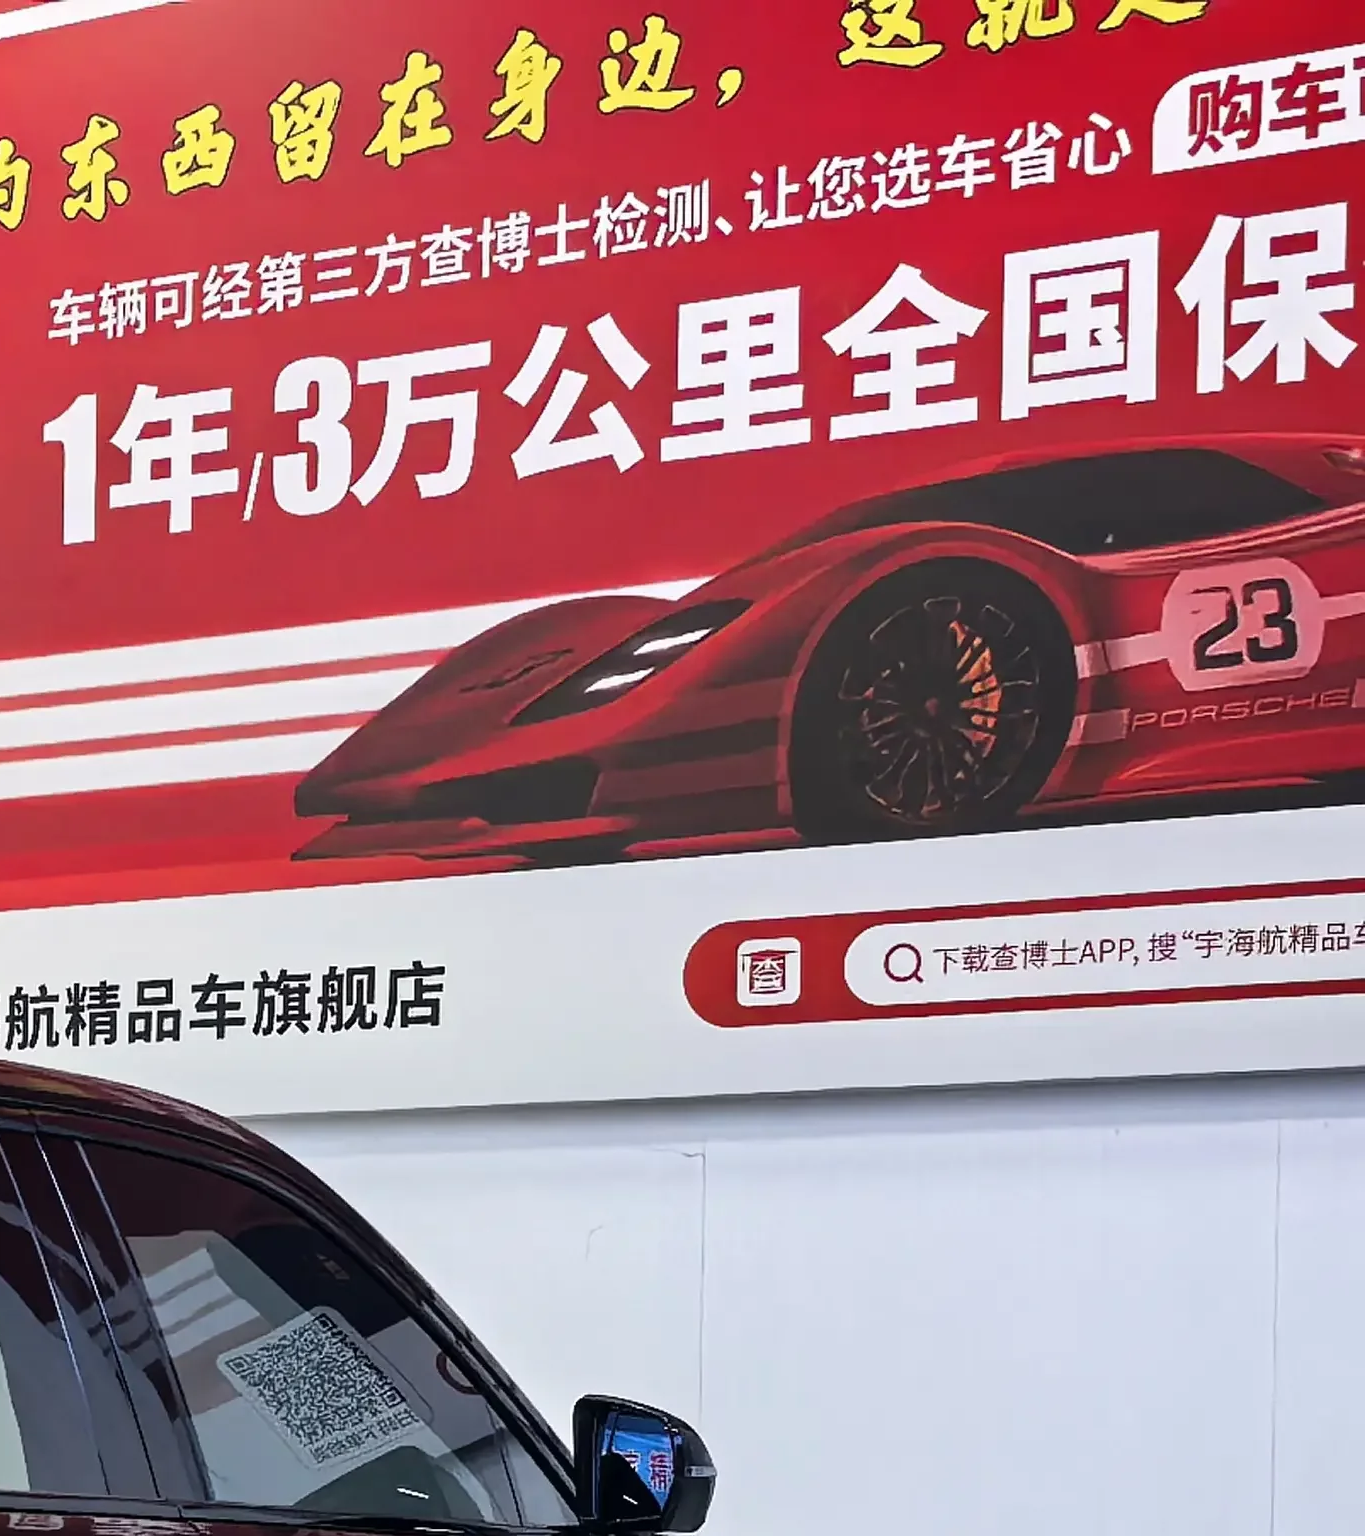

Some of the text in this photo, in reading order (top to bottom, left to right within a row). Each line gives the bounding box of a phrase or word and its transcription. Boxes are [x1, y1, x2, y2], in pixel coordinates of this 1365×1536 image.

[1187, 59, 1365, 157] 购车
[1189, 577, 1299, 671] 23
[1130, 687, 1351, 733] PORSCHE
